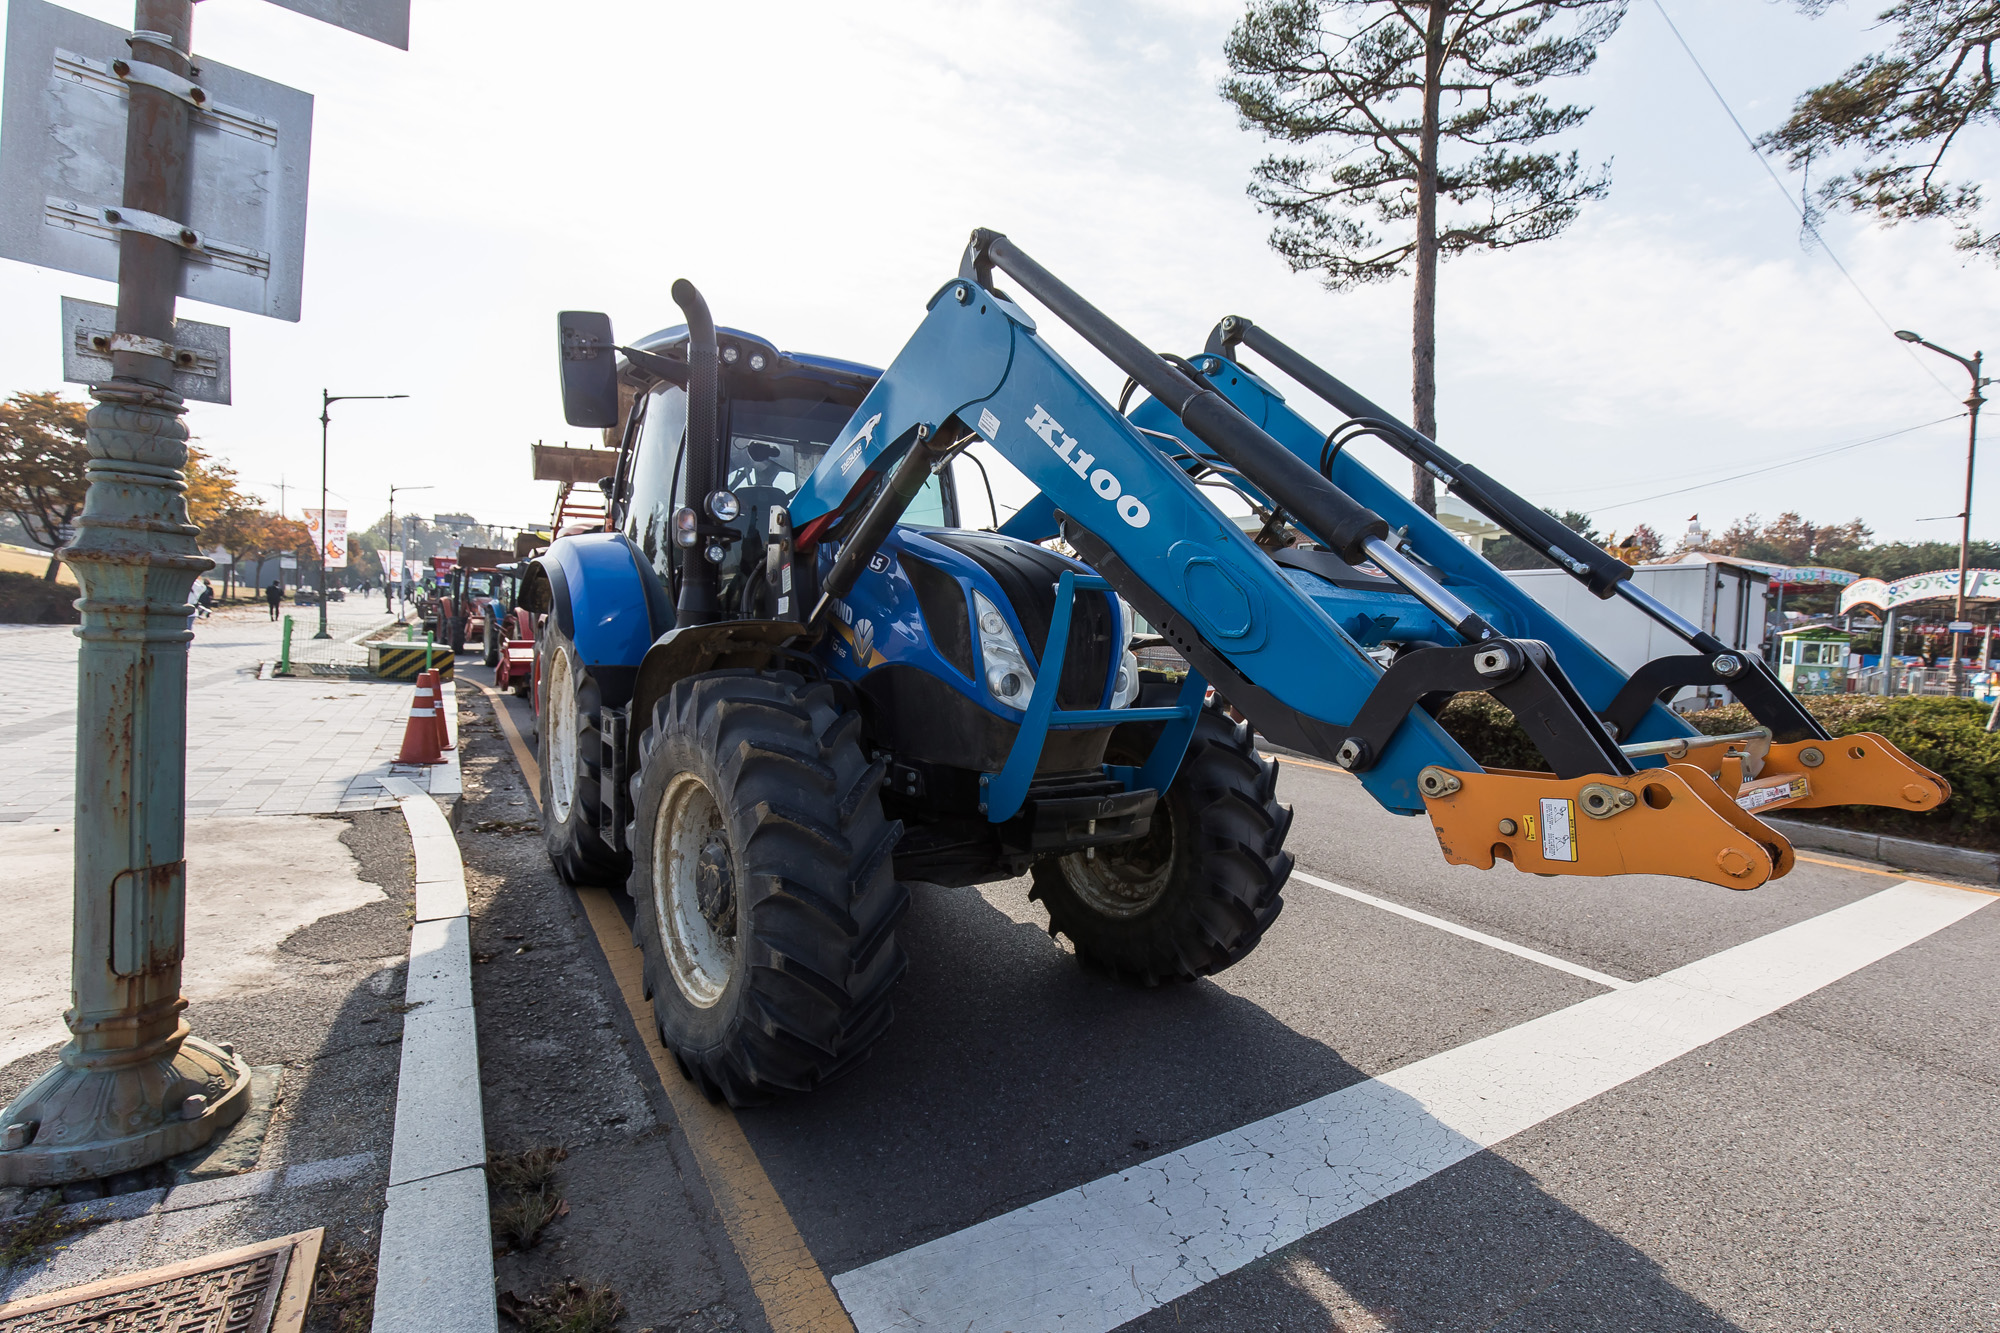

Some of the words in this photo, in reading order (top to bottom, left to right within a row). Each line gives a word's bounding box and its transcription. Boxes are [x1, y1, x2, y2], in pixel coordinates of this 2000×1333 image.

[841, 443, 862, 472] TAESUNG
[1025, 404, 1150, 528] K1100
[870, 556, 883, 570] LS
[831, 597, 853, 625] AND
[223, 1292, 257, 1333] ICE
